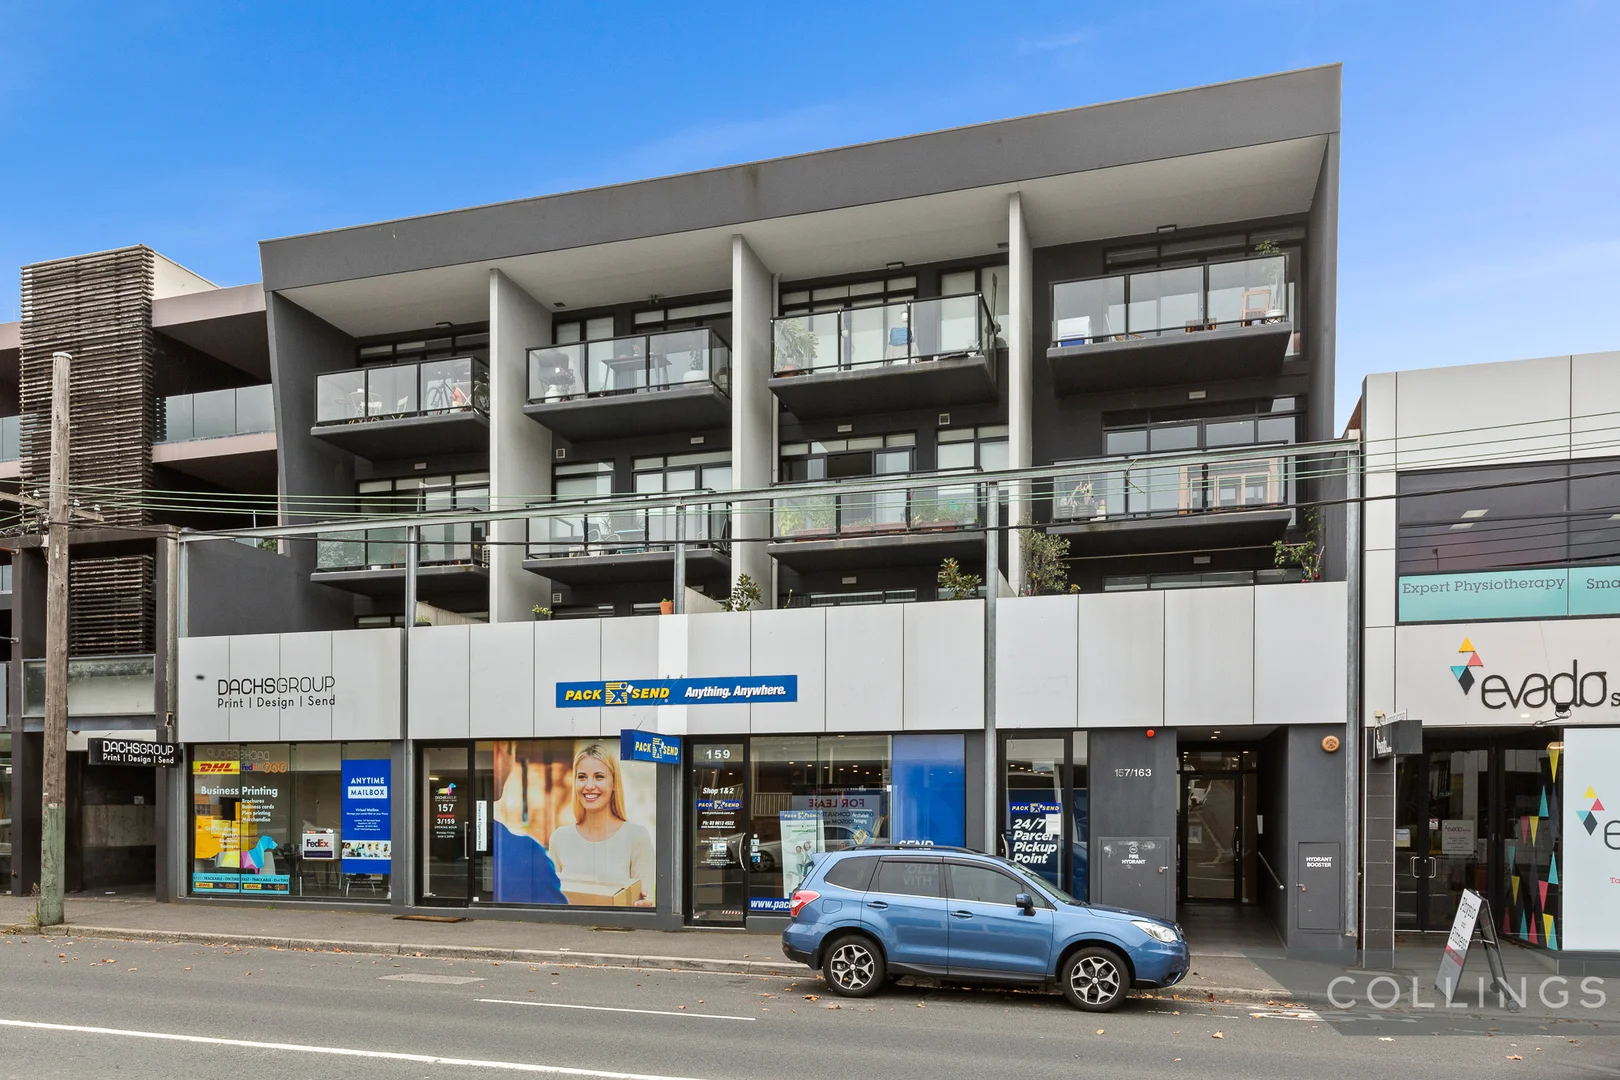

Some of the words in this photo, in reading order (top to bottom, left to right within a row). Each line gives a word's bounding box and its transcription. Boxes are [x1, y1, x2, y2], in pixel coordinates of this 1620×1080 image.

[1402, 581, 1450, 596] Expert
[1454, 577, 1566, 594] Physiotherapy
[218, 675, 336, 696] DACHSGROUP
[1481, 659, 1607, 709] evado
[565, 689, 602, 702] PACK
[631, 687, 670, 699] SEND
[685, 686, 731, 700] Anything.
[733, 685, 787, 698] Anywhere.
[218, 697, 244, 709] Print
[257, 697, 294, 710] Design
[308, 695, 336, 707] Send
[102, 741, 174, 757] DACHSGROUP
[635, 742, 652, 753] PACK
[663, 745, 679, 756] SEND
[706, 749, 731, 760] 159
[103, 754, 120, 762] Print
[128, 755, 150, 764] Design
[158, 757, 174, 765] Send
[200, 763, 233, 773] DHL
[1114, 768, 1152, 777] 157/163
[350, 777, 385, 785] ANYTIME
[201, 786, 240, 796] Business
[241, 786, 279, 799] Printing
[703, 787, 719, 796] Shop
[438, 804, 454, 812] 157
[254, 810, 272, 818] printing
[1013, 818, 1046, 831] 24/7
[1013, 830, 1054, 841] Parcel
[306, 838, 329, 848] FedEx
[1013, 842, 1058, 855] Pickup
[1013, 853, 1049, 864] Point
